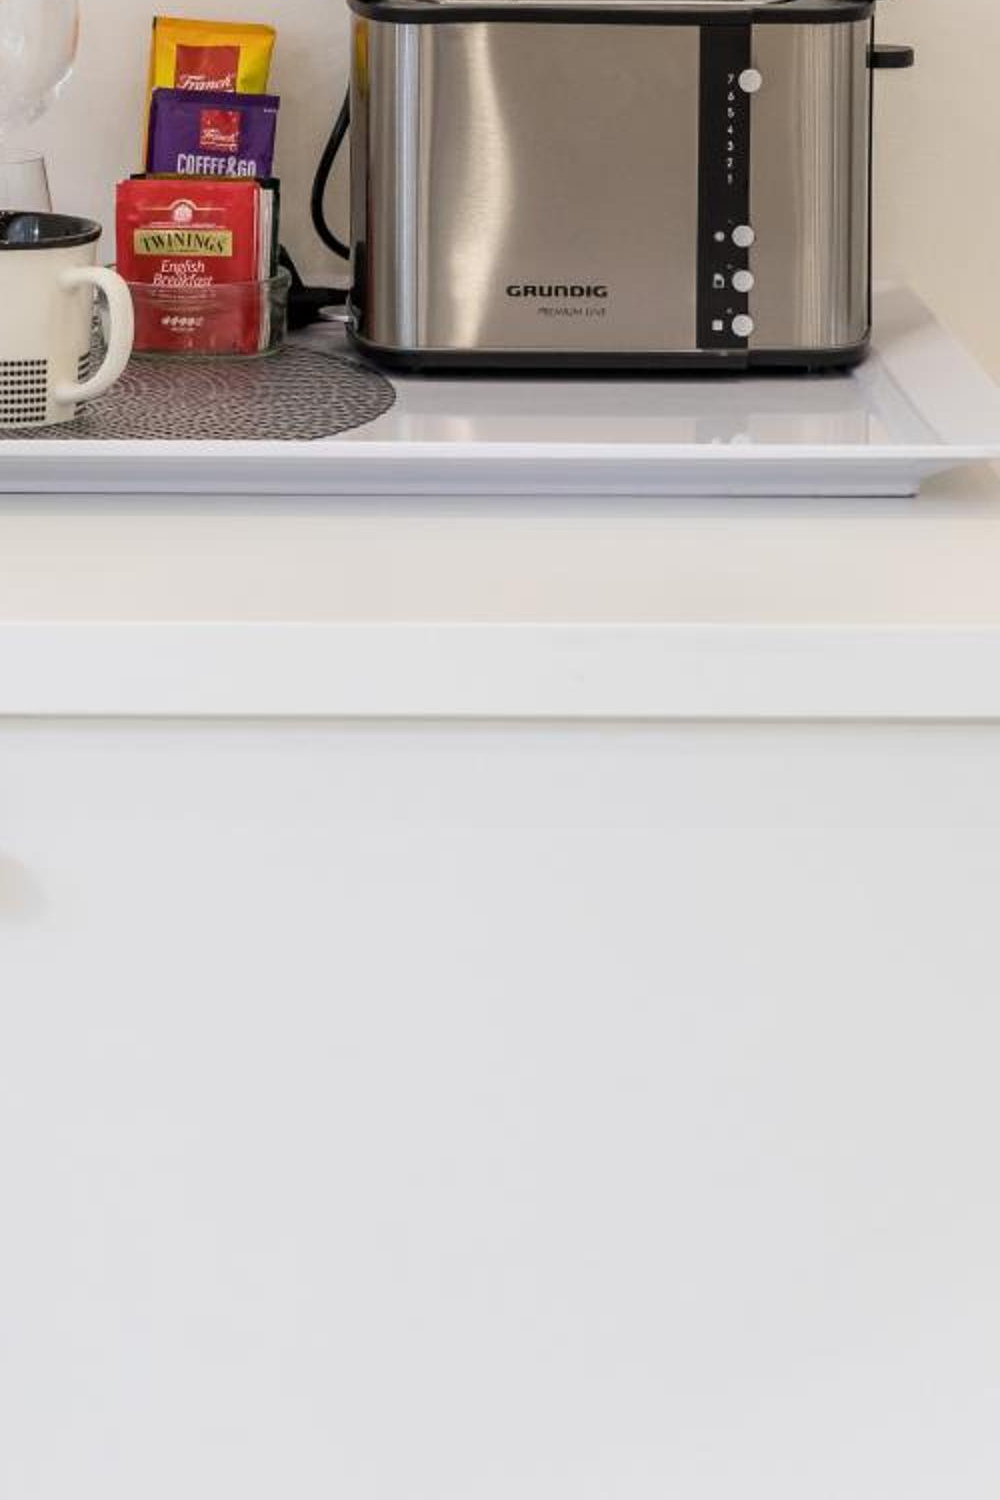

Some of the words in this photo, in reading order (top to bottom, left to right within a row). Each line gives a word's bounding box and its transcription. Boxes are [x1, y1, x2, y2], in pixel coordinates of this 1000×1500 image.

[727, 73, 735, 85] 7
[727, 91, 735, 101] 6
[727, 107, 735, 118] 5
[727, 124, 734, 134] 4
[727, 141, 734, 151] 3
[727, 157, 733, 168] 2
[142, 232, 225, 253] TWININGS
[161, 260, 205, 276] English
[152, 273, 213, 287] Breakfast
[506, 285, 607, 298] GRUNDIG
